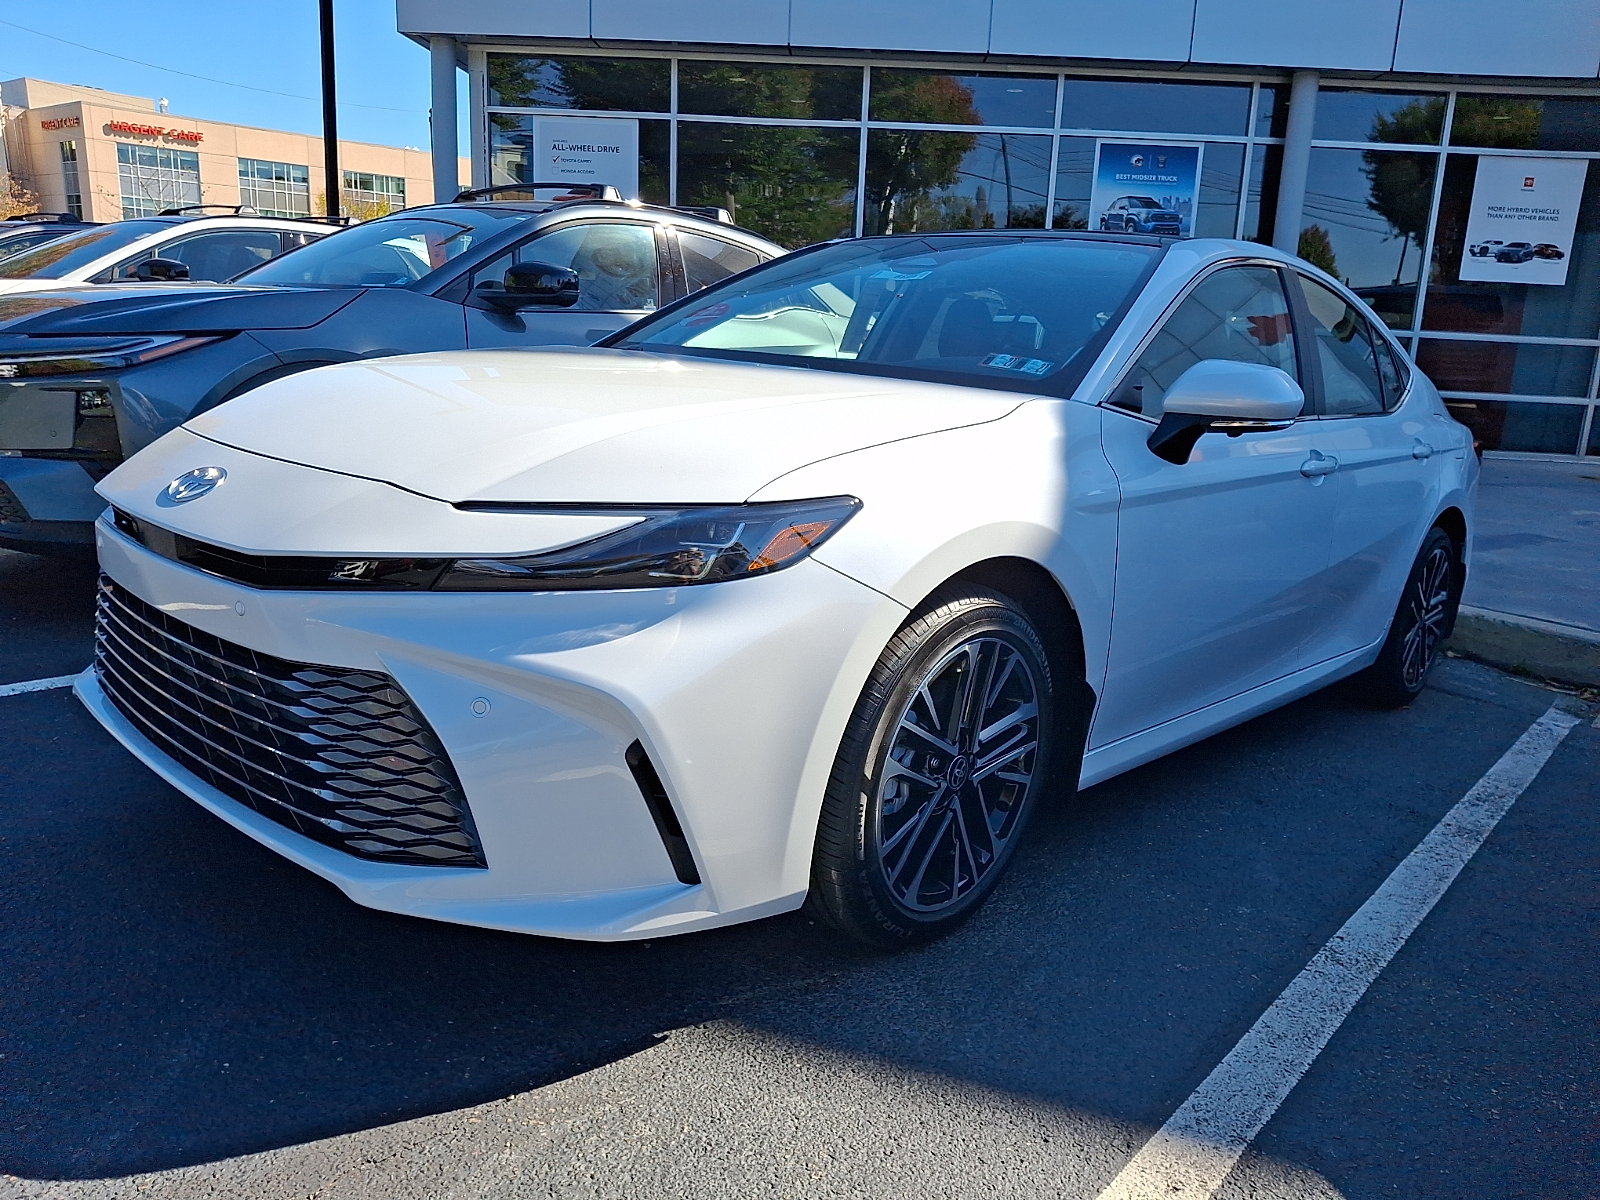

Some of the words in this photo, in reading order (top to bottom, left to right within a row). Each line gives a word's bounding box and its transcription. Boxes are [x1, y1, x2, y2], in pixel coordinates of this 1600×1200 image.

[41, 117, 62, 131] URGENT
[62, 116, 79, 128] CARE
[110, 120, 165, 137] URGENT
[169, 128, 204, 142] CARE
[551, 143, 596, 153] ALL-WHEEL
[597, 145, 620, 154] DRIVE
[1506, 206, 1530, 214] HYBRID
